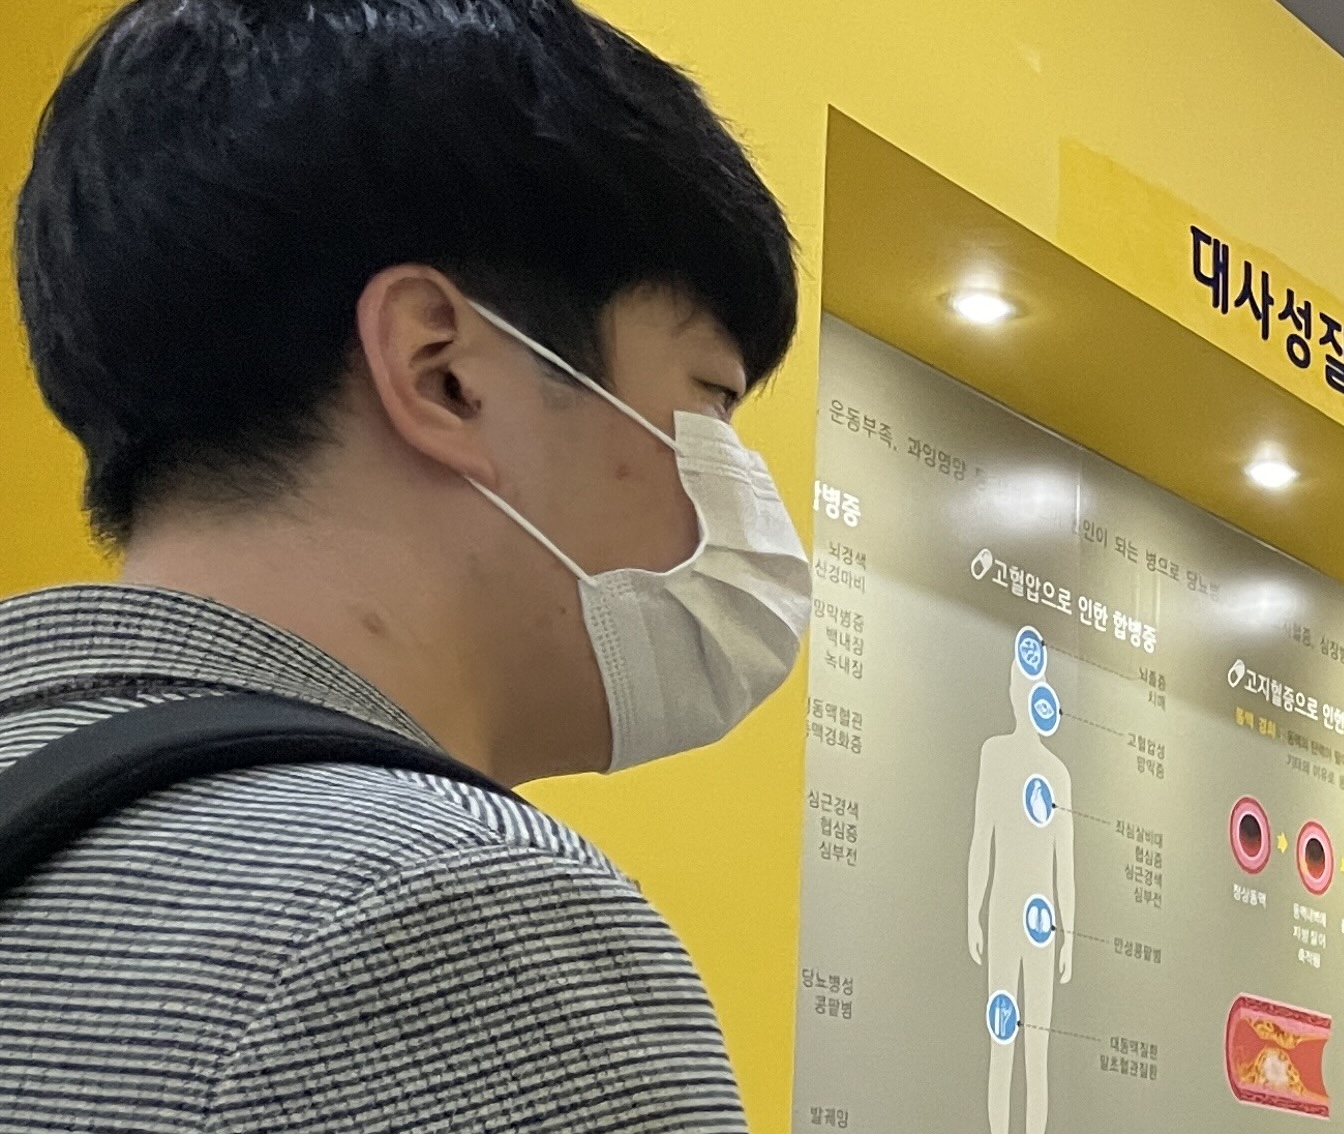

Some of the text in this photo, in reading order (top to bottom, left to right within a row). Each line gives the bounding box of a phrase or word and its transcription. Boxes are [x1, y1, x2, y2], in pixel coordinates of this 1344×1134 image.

[829, 399, 899, 452] 운동부족,
[907, 436, 967, 482] 과잉영양
[1074, 519, 1108, 548] 인이
[1114, 536, 1138, 564] 되는
[1146, 549, 1181, 582] 병으로
[829, 540, 867, 570] 뇌경색
[814, 558, 866, 594] 신경마비
[813, 599, 864, 634] 망막병증
[991, 558, 1157, 654] 고혈압으로 인한 합병증
[825, 627, 864, 656] 백내장
[824, 650, 863, 680] 녹내장
[1138, 667, 1167, 692] 뇌졸중
[1243, 668, 1319, 721] 고지혈증으로
[807, 697, 863, 731] 동맥혈관
[1127, 733, 1166, 760] 고혈압성
[807, 790, 859, 820] 심근경색
[820, 816, 858, 843] 협심증
[1115, 819, 1164, 849] 좌심실비대
[819, 841, 857, 867] 심부전
[1134, 844, 1162, 869] 협심증
[1124, 864, 1163, 890] 심근경색
[1133, 886, 1162, 910] 심부전
[1233, 883, 1267, 909] 정상동맥
[801, 968, 853, 996] 당뇨병성
[814, 995, 853, 1020] 콩팥병
